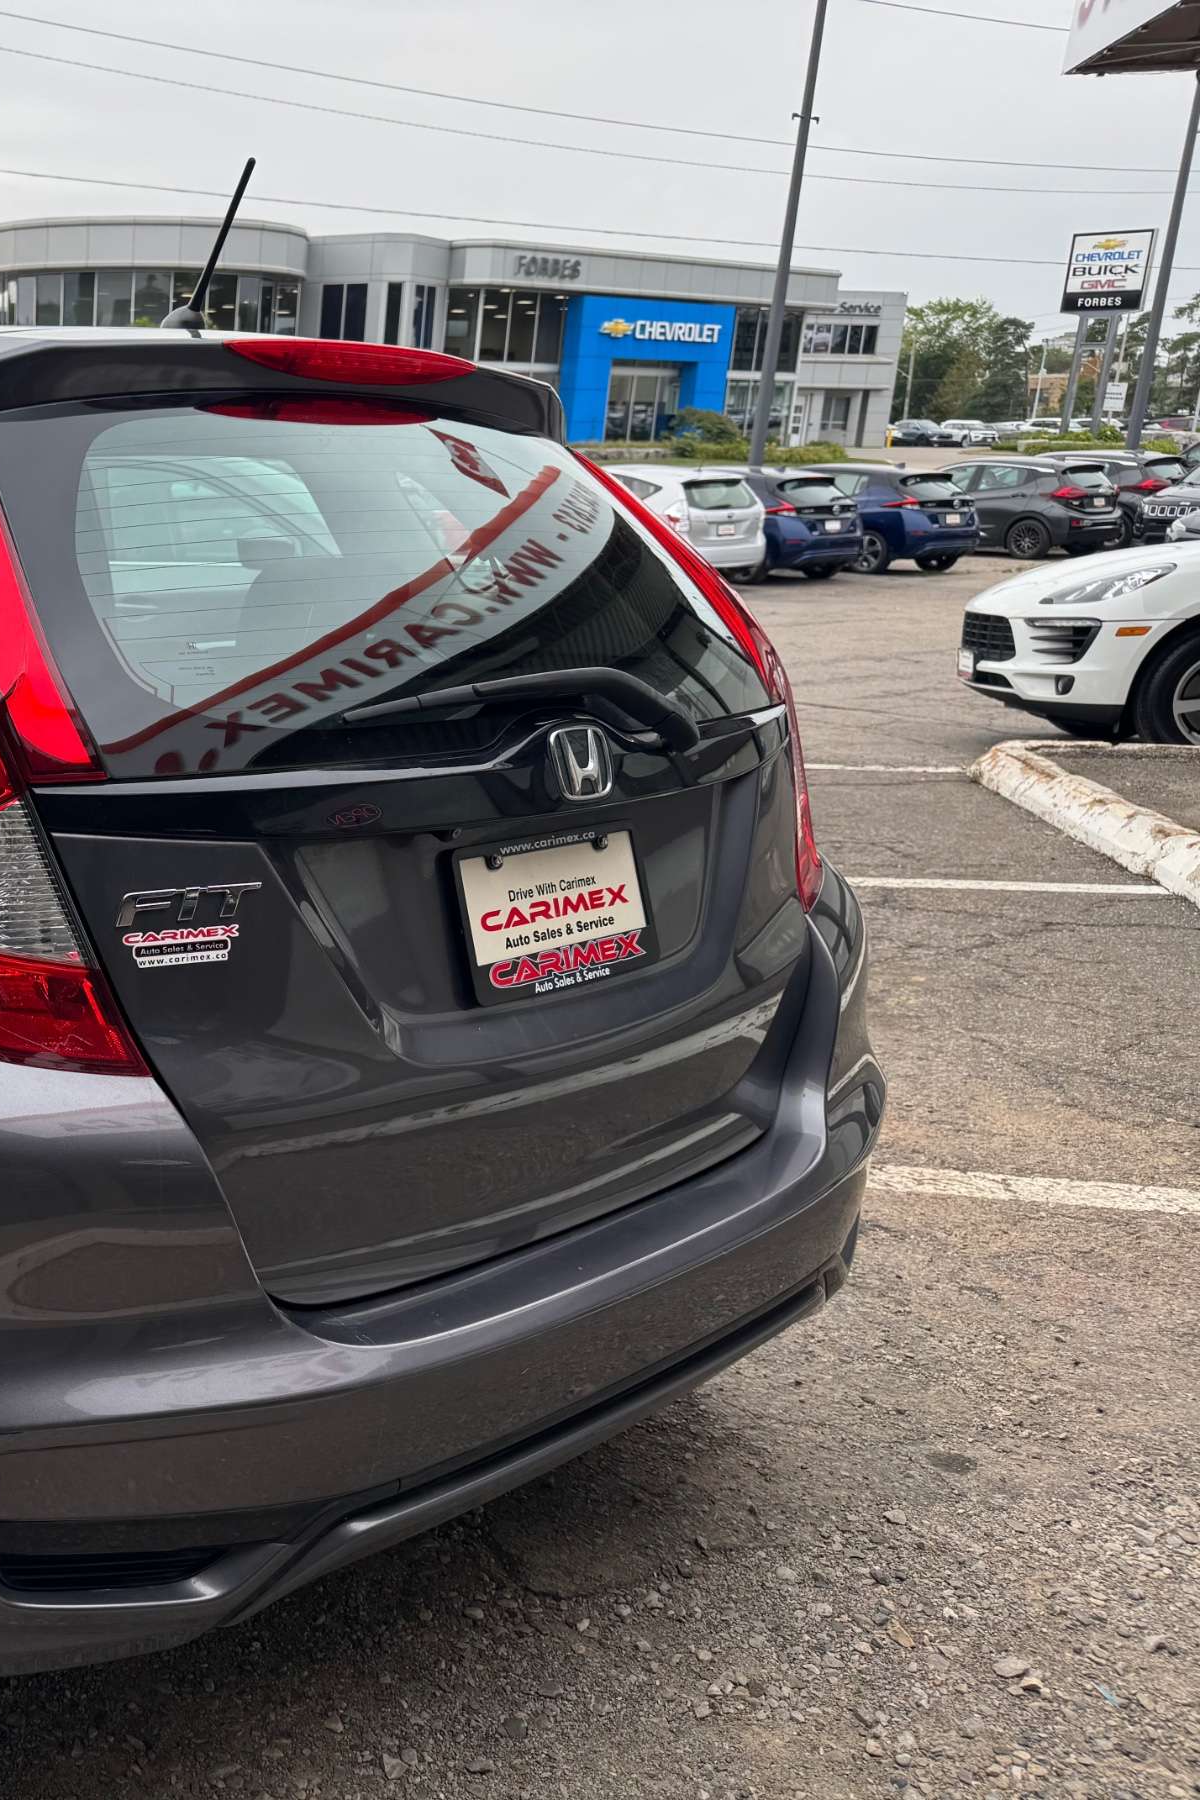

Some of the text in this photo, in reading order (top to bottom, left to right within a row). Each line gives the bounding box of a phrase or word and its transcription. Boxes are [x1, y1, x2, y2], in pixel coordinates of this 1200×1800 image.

[513, 255, 581, 280] FORBES
[1075, 250, 1143, 262] CHEVROLET
[1072, 264, 1139, 276] BUICK
[1080, 278, 1127, 289] GMC
[840, 301, 882, 314] Service
[1077, 297, 1122, 307] FORBES
[635, 320, 722, 343] CHEVROLET
[508, 875, 597, 902] Drive With Carimex
[116, 882, 262, 927] FIT
[480, 883, 629, 932] CARIMEX
[123, 924, 239, 945] CARIMEX
[505, 915, 615, 950] Auto Sales & Service
[140, 947, 160, 956] Auto
[163, 945, 184, 954] Sales
[195, 941, 225, 950] Service
[490, 930, 646, 988] CARIMEX
[535, 966, 611, 993] Auto Sales & Service
